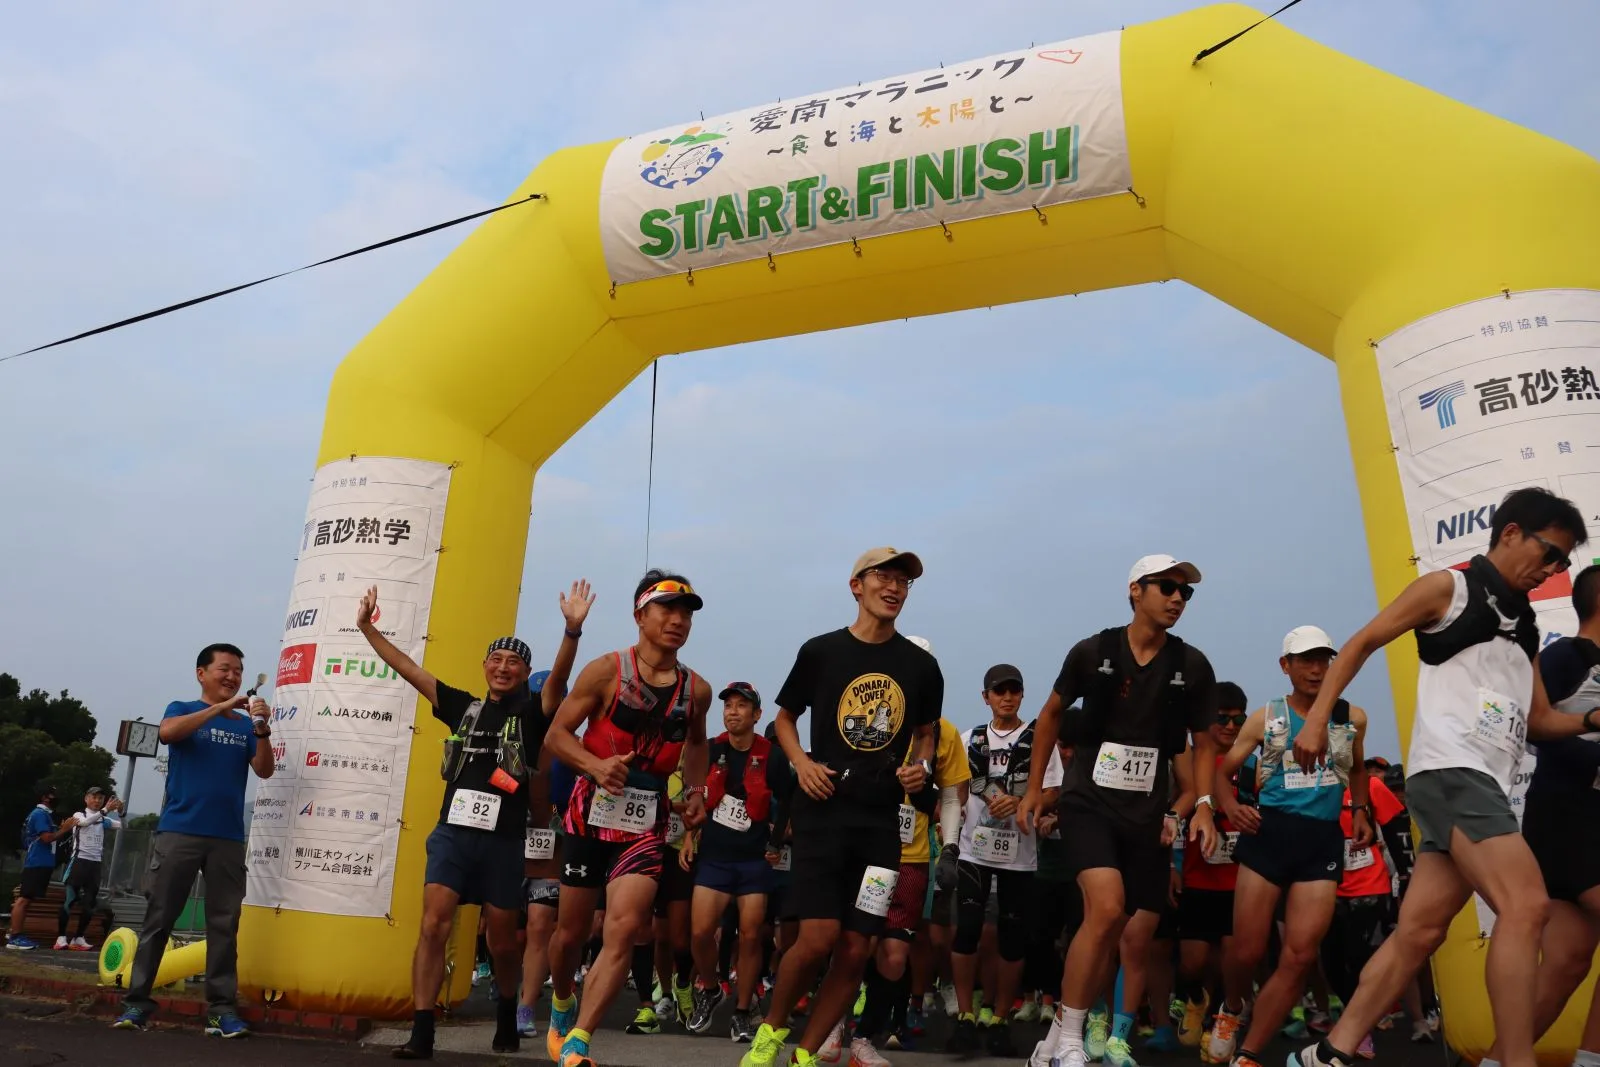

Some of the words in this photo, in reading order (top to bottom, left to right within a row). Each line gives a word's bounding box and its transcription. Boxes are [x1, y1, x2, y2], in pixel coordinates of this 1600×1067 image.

[749, 56, 1026, 134] 愛南マラニック
[637, 123, 1077, 258] START&FINISH
[1480, 315, 1549, 337] 特別協賛
[313, 516, 411, 547] 高砂熱学
[852, 679, 891, 698] DONARAI
[859, 689, 885, 706] LOVER
[1122, 759, 1152, 776] 417
[472, 802, 490, 817] 82
[624, 801, 647, 819] 86
[729, 806, 749, 821] 159
[528, 837, 551, 849] 392
[994, 839, 1010, 852] 68
[294, 860, 373, 876] ファーム合同会社
